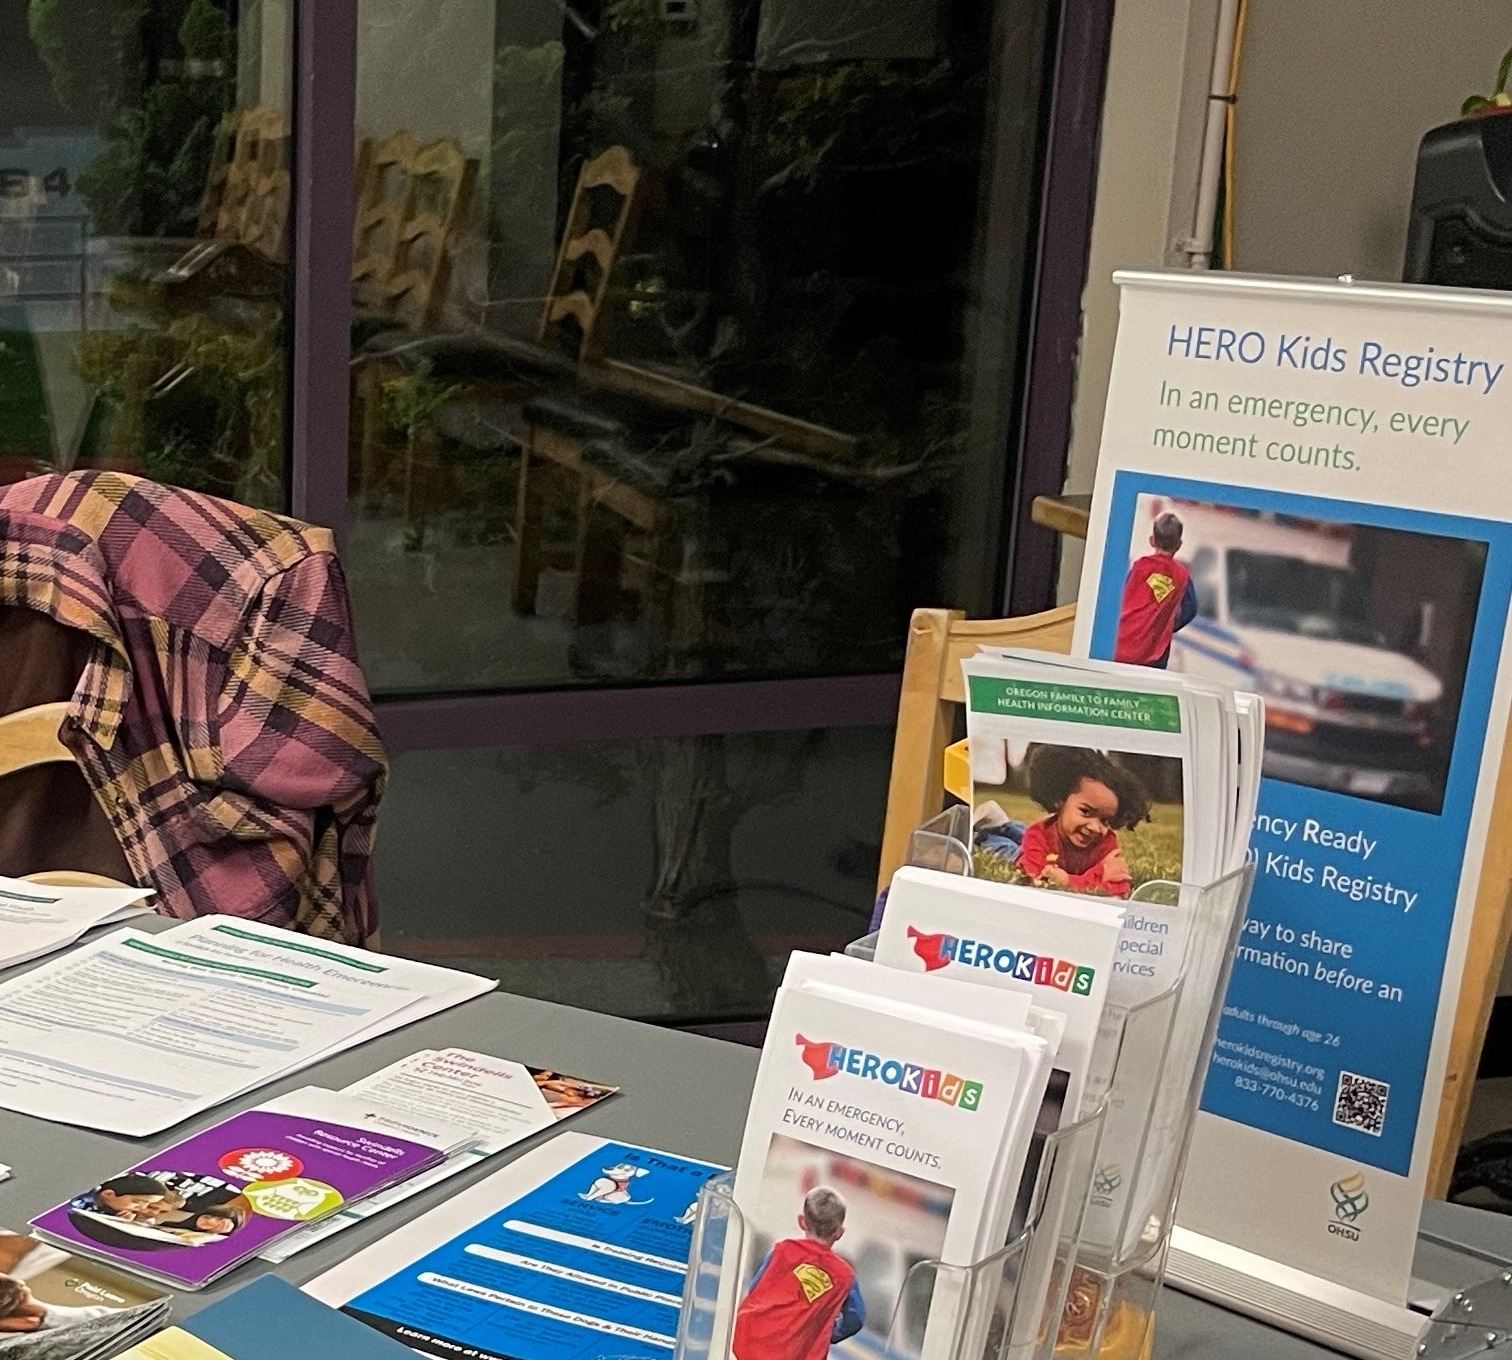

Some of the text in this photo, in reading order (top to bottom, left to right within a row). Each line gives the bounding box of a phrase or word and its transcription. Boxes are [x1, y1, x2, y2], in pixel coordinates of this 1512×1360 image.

[1168, 324, 1504, 394] HERO Kids Registry
[1159, 381, 1470, 444] In an emergency, every
[1153, 427, 1361, 471] moment counts.
[997, 698, 1151, 722] HEALTH INFORMATION CENTER
[1005, 687, 1140, 708] OREGON FAMILY TO FAMILY
[1303, 819, 1377, 860] Ready
[1265, 855, 1418, 912] Kids Registry
[1276, 923, 1353, 959] to share
[1314, 964, 1402, 1002] before an
[1257, 1015, 1300, 1034] through
[1302, 1028, 1322, 1042] age
[1324, 1033, 1340, 1047] 26
[1235, 1076, 1319, 1111] 833-770-4376
[1328, 1223, 1360, 1241] OHSU
[397, 1326, 430, 1342] Learn
[431, 1338, 463, 1352] more
[463, 1348, 478, 1357] at
